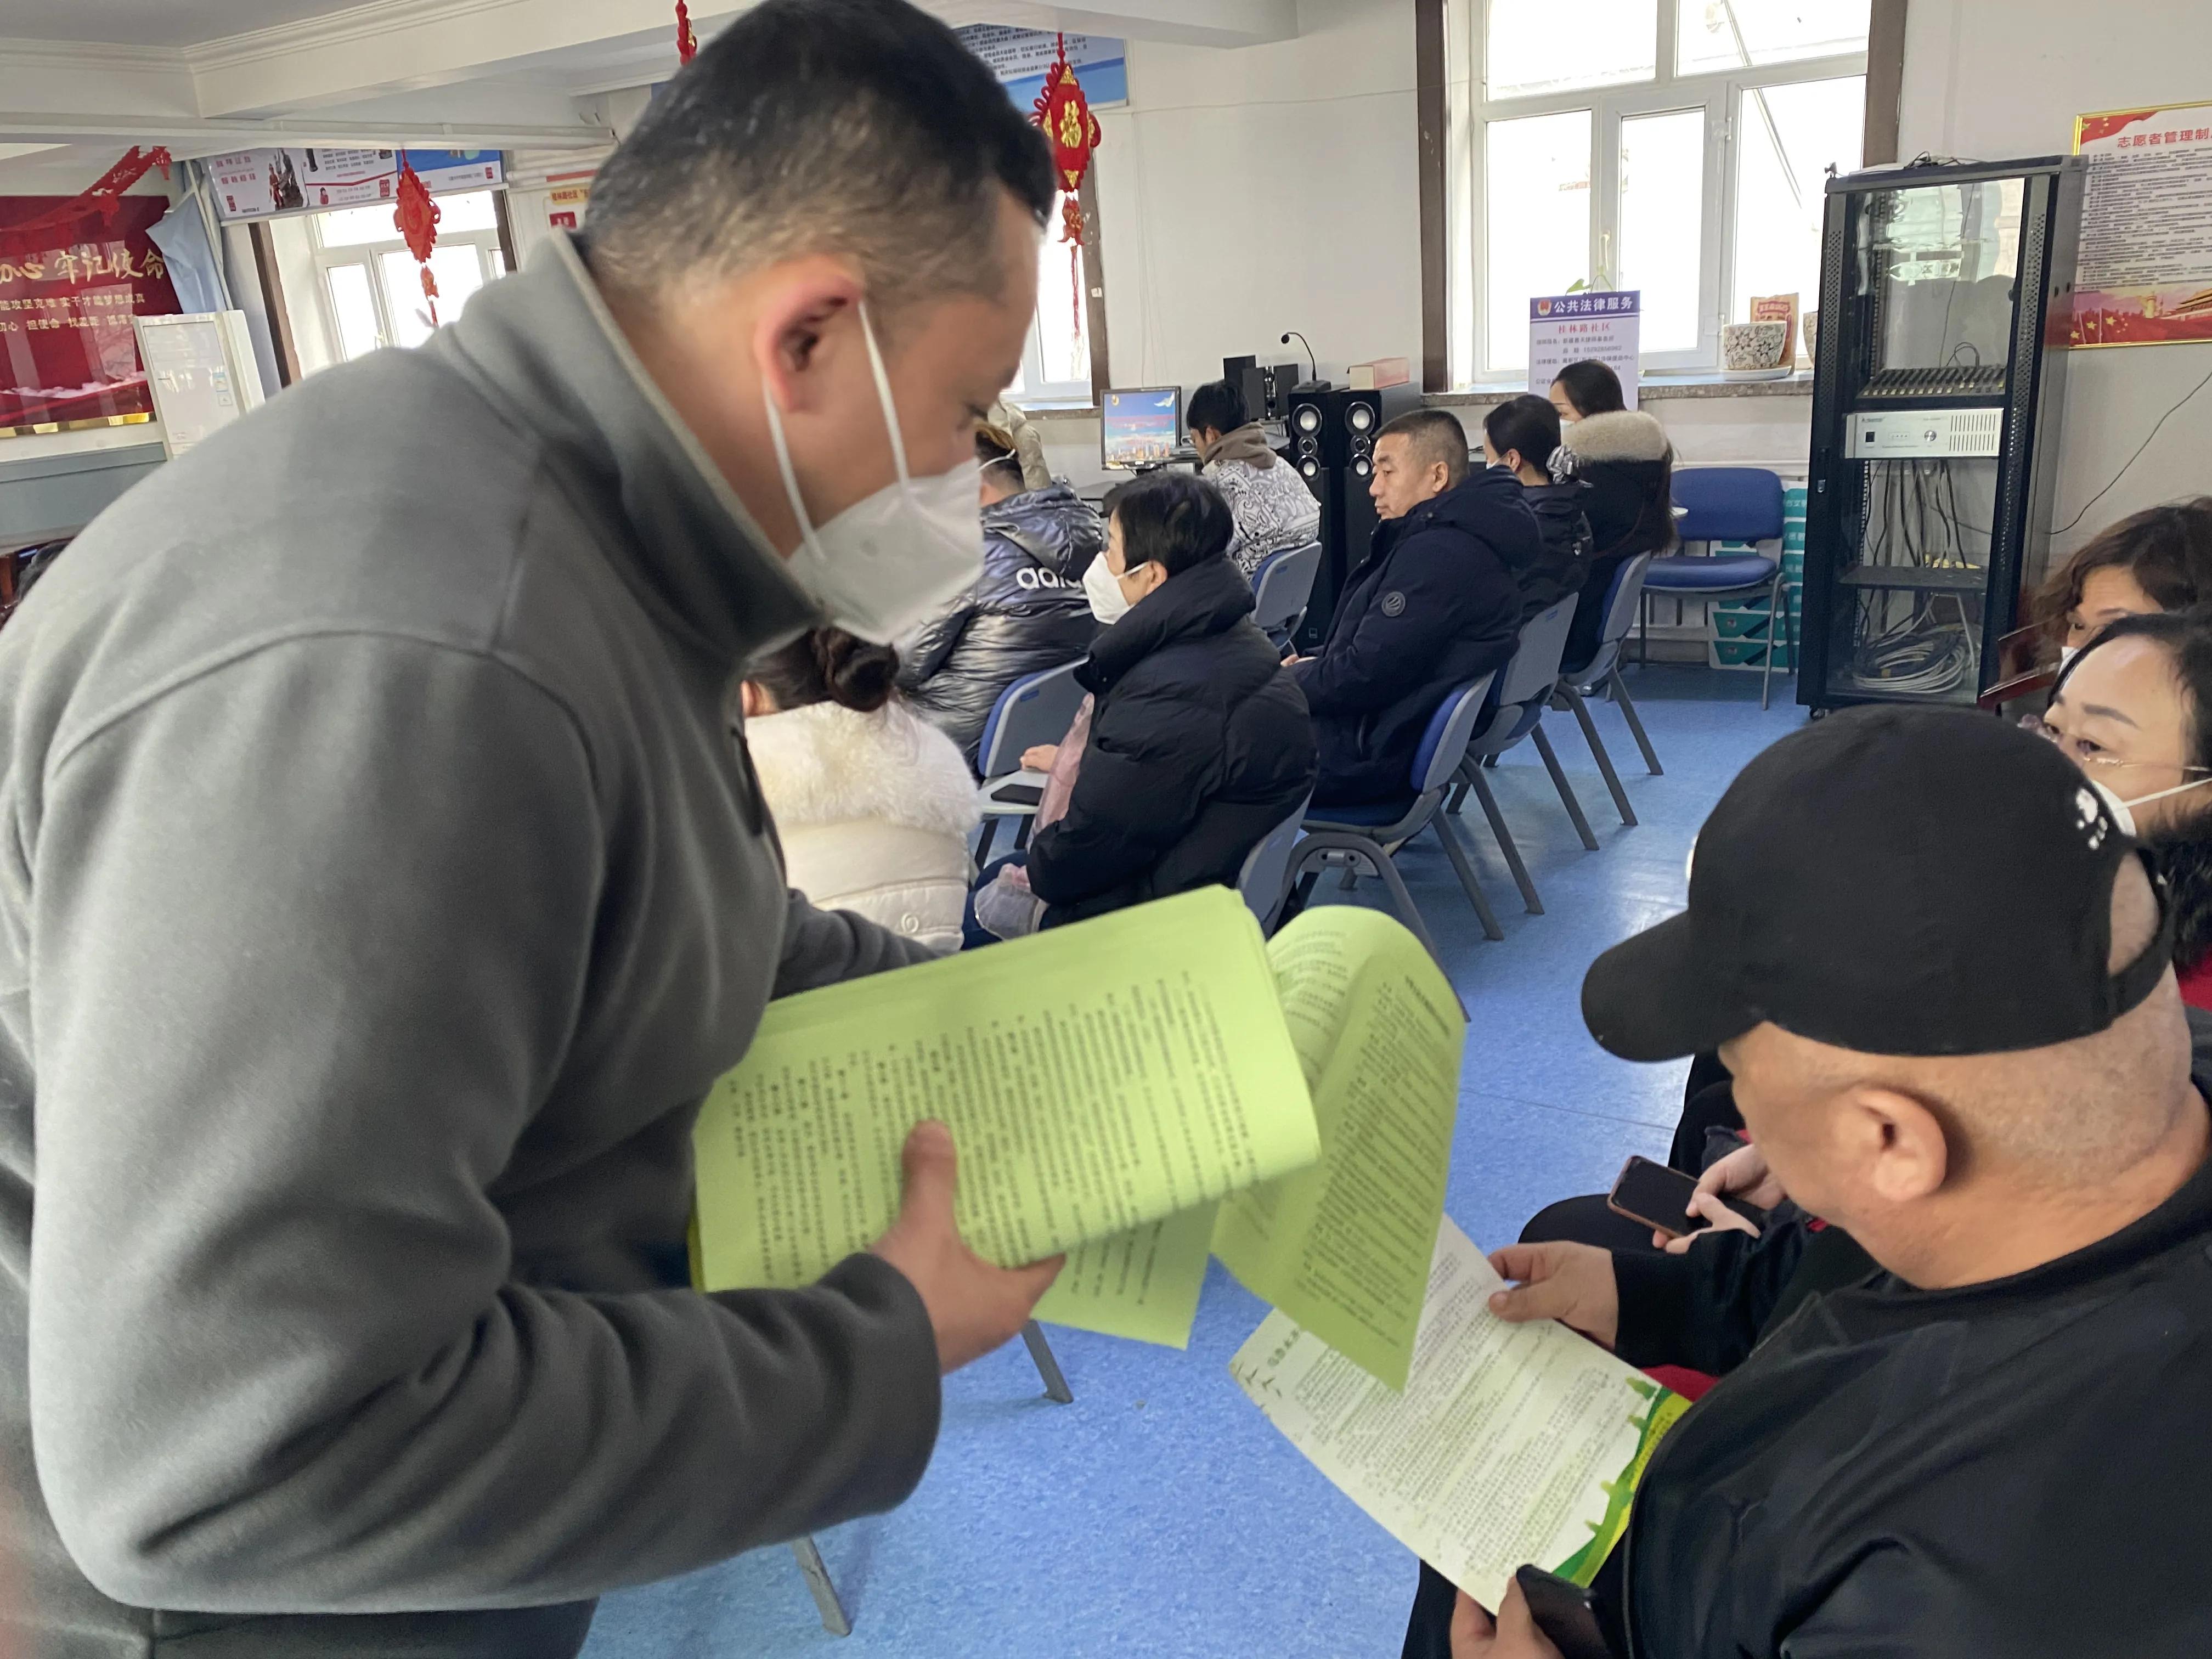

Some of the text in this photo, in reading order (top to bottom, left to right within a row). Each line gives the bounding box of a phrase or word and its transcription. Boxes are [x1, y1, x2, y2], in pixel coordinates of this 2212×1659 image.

[2117, 127, 2212, 148] 志愿者管理制
[1554, 296, 1633, 313] 公共法律服务
